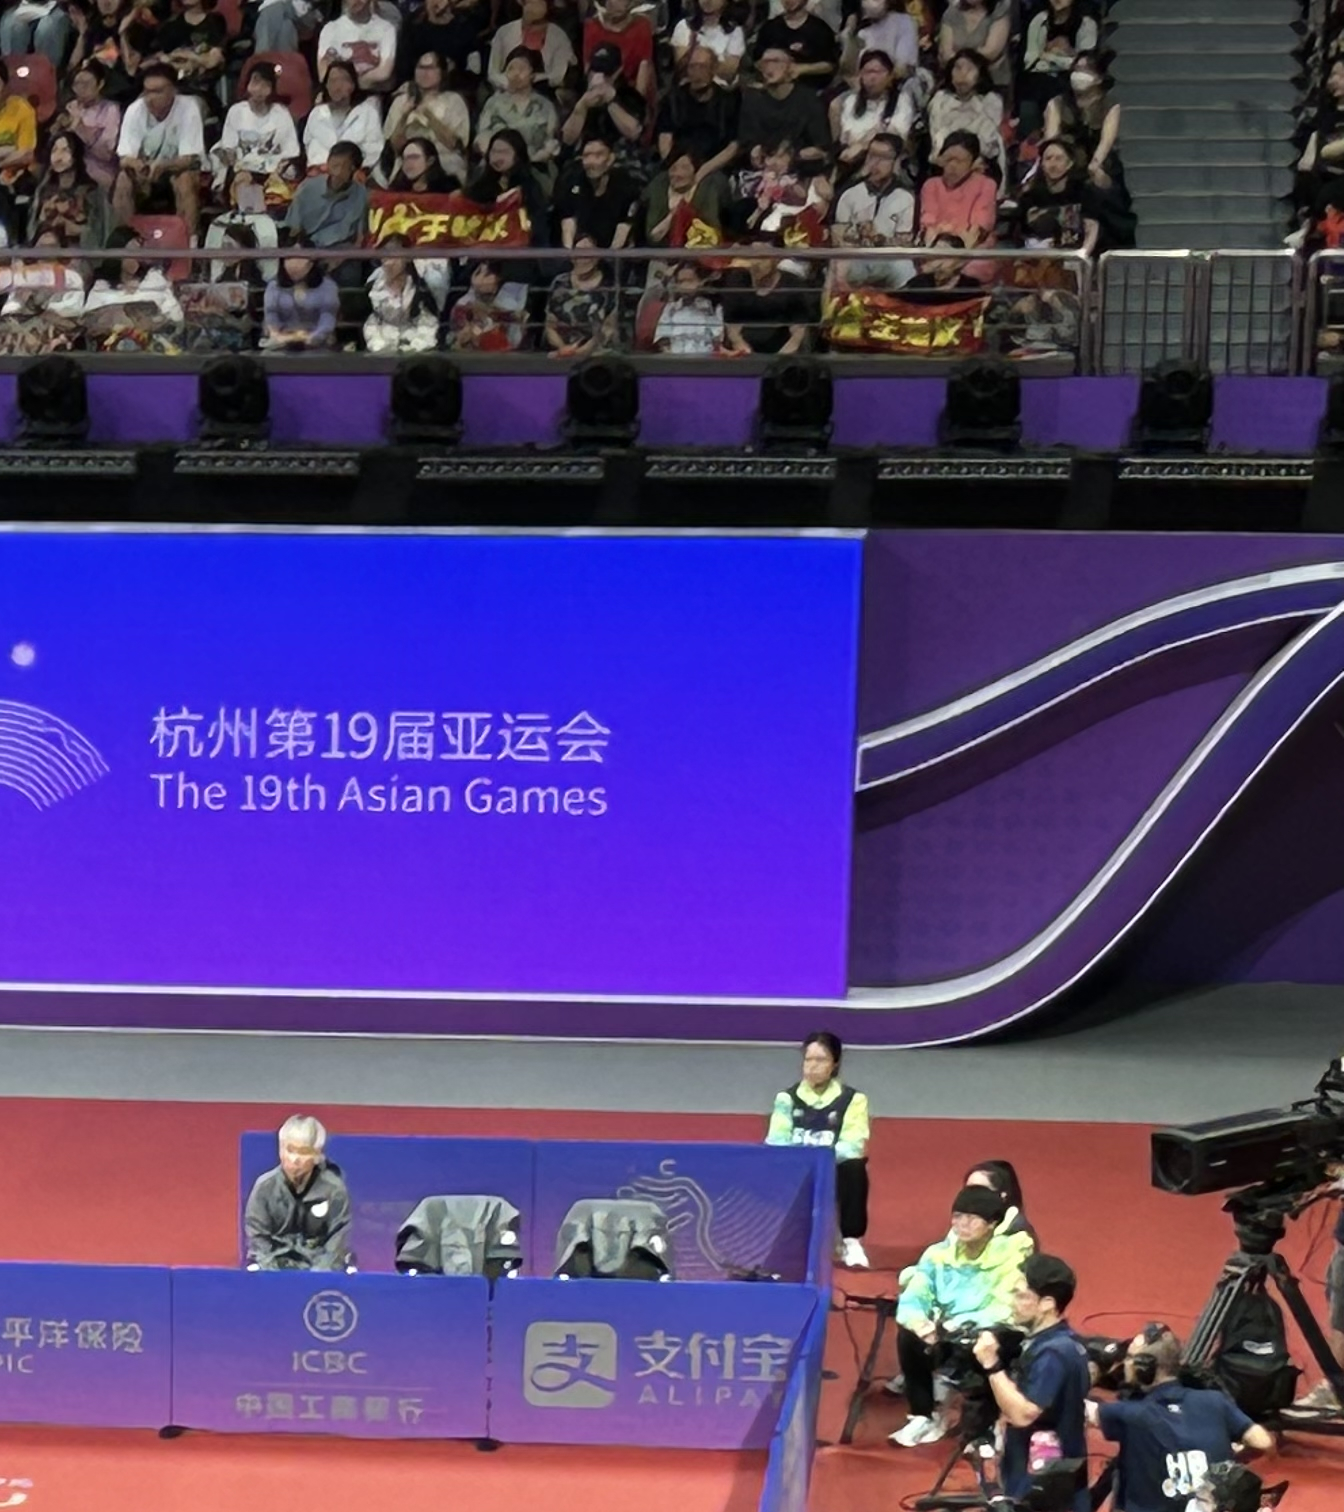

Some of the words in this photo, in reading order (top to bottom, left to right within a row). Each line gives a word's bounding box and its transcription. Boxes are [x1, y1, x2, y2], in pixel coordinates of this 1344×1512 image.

[150, 705, 612, 764] 杭州第19届亚运会
[150, 773, 226, 811] The
[240, 774, 326, 812] 19th
[339, 775, 451, 814] Asian
[464, 777, 609, 816] Games
[292, 1350, 368, 1374] ICBC
[634, 1330, 793, 1382] 支付宝
